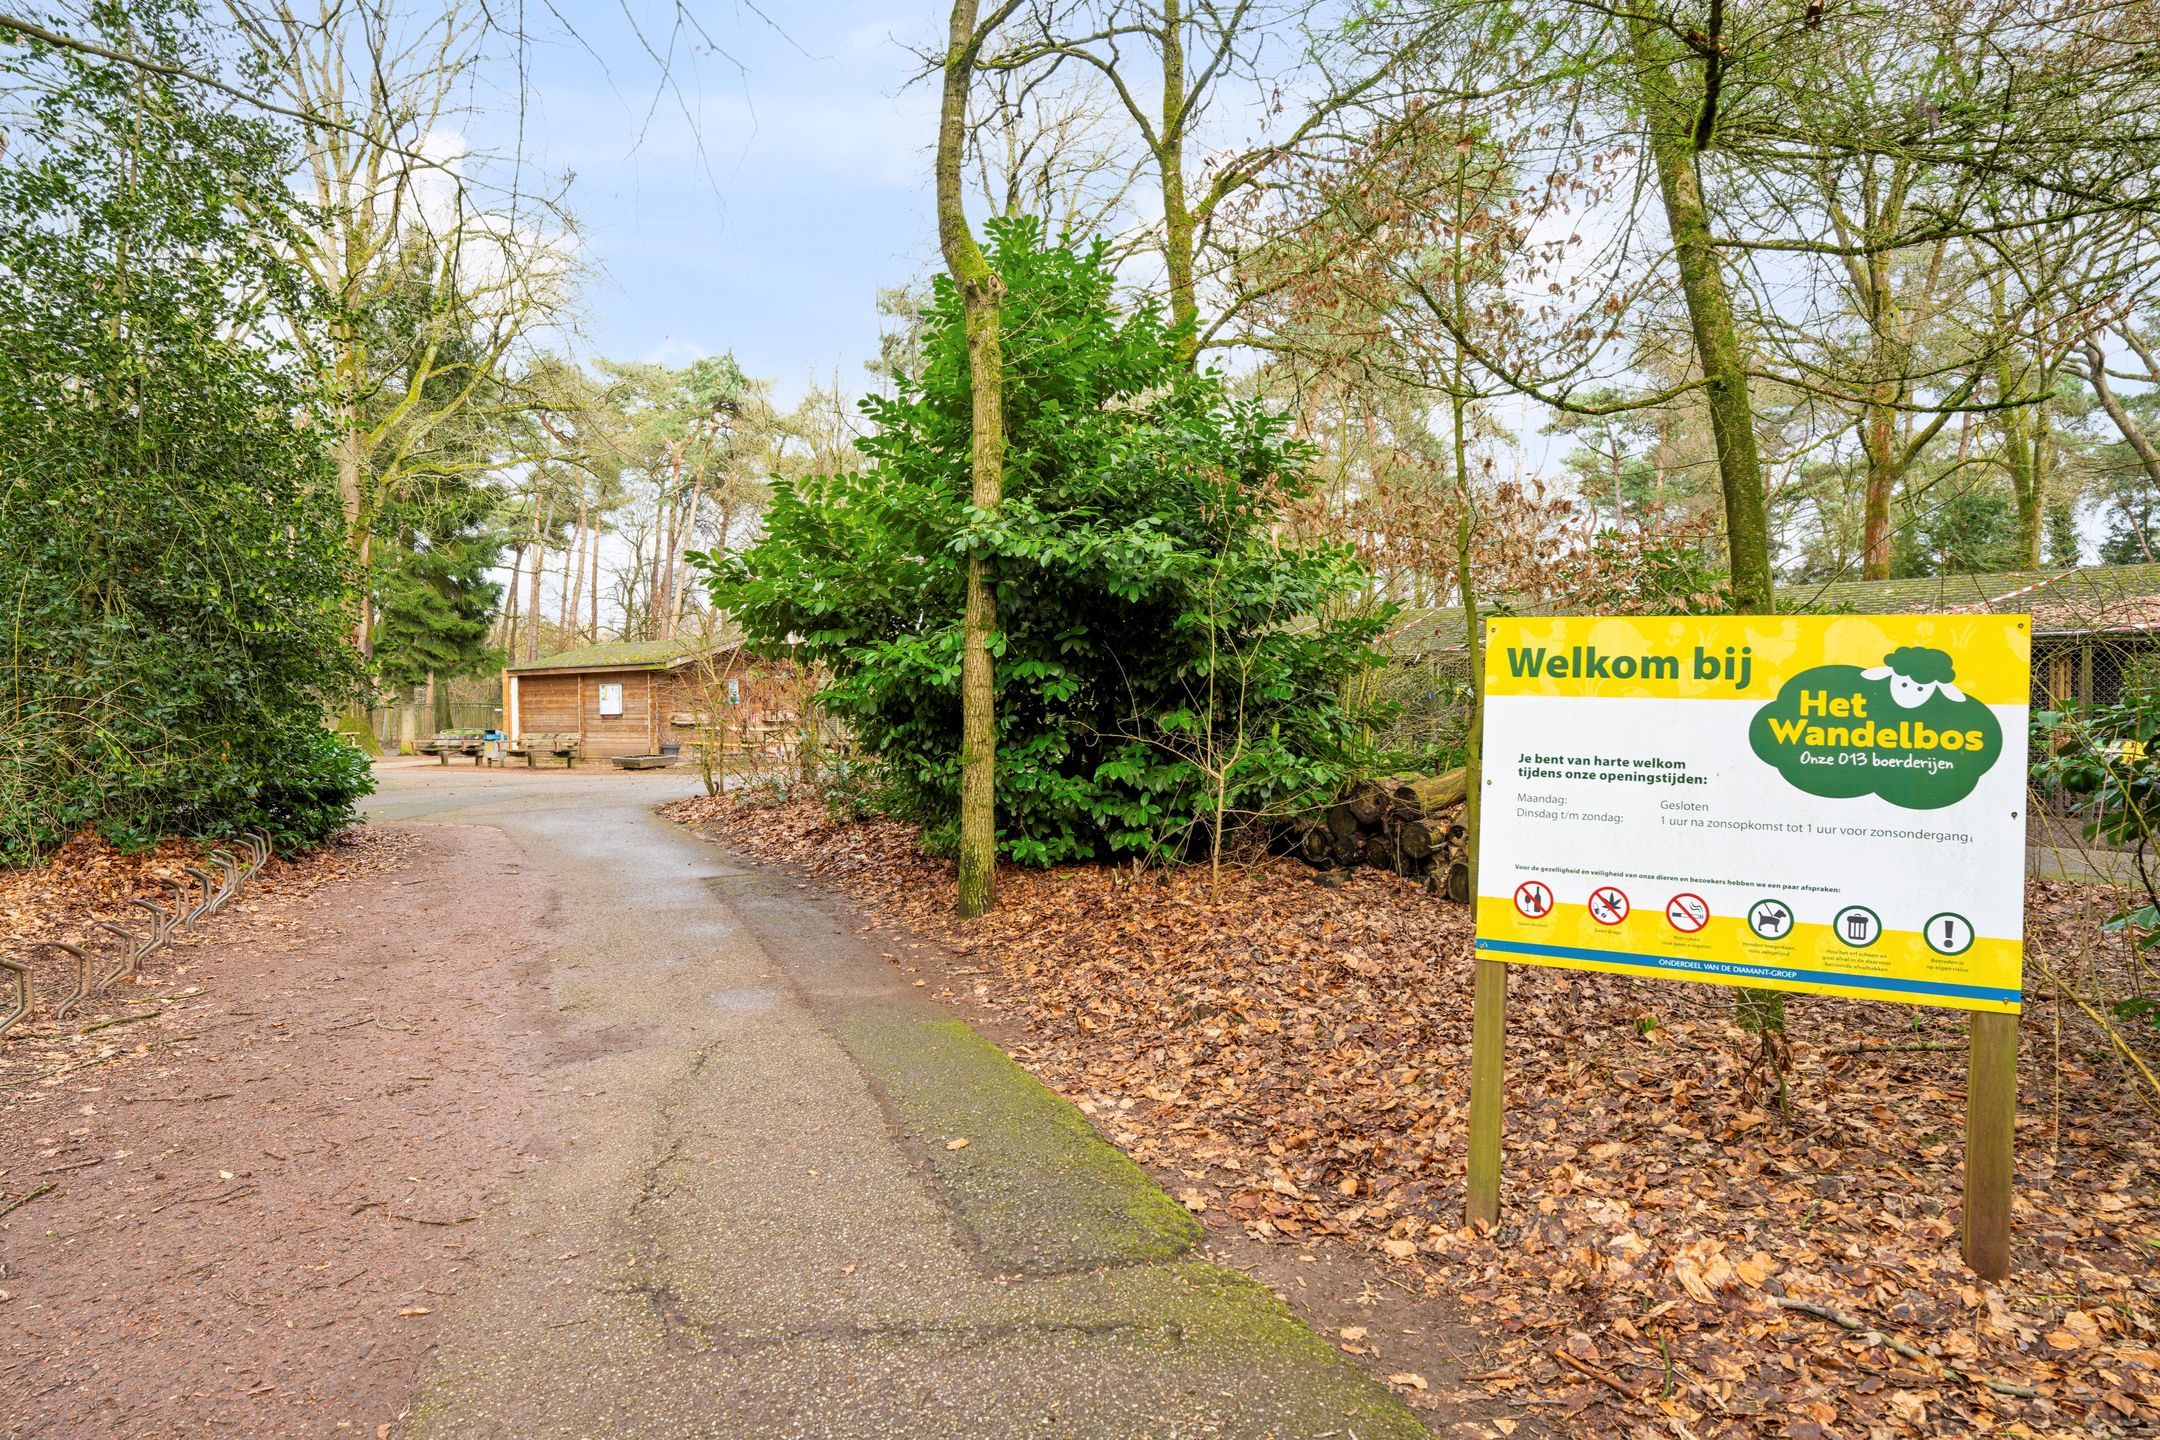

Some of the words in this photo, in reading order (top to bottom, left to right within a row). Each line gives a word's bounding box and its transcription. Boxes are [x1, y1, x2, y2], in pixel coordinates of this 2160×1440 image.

[1507, 646, 1679, 679] Welkom
[1694, 646, 1752, 690] bij
[1800, 690, 1867, 718] Het
[1768, 718, 1984, 751] Wandelbos
[1518, 753, 1532, 764] Je
[1535, 754, 1564, 765] bent
[1567, 757, 1591, 766] van
[1594, 756, 1630, 768] harte
[1633, 758, 1686, 769] welkom
[1800, 751, 1834, 765] Onze
[1838, 752, 1868, 767] 013
[1872, 752, 1954, 775] boerderijen
[1518, 767, 1562, 780] tijdens
[1565, 771, 1597, 780] onze
[1600, 771, 1708, 786] openingstijden:
[1517, 793, 1568, 805] Maandag:
[1660, 800, 1709, 812] Gesloten
[1516, 807, 1558, 821] Dinsdag
[1561, 811, 1579, 821] t/m
[1581, 812, 1624, 825] zondag:
[1661, 816, 1665, 825] 1
[1669, 818, 1689, 826] uur
[1691, 819, 1704, 827] na
[1707, 820, 1783, 832] zonsopkomst
[1786, 823, 1804, 833] tot
[1807, 823, 1812, 833] 1
[1816, 826, 1838, 835] uur
[1840, 827, 1867, 836] voor
[1870, 828, 1969, 844] zonsondergang
[1540, 866, 1580, 875] gezelligheid
[1591, 870, 1624, 878] veiligheid
[1690, 876, 1726, 885] bezoekers
[1727, 879, 1755, 887] hebben
[1801, 884, 1841, 893] afspraken:
[1659, 958, 1702, 969] ONDERDEEL
[1703, 963, 1720, 971] VAN
[1721, 964, 1732, 972] DE
[1733, 966, 1798, 979] DIAMANT-GROEP
